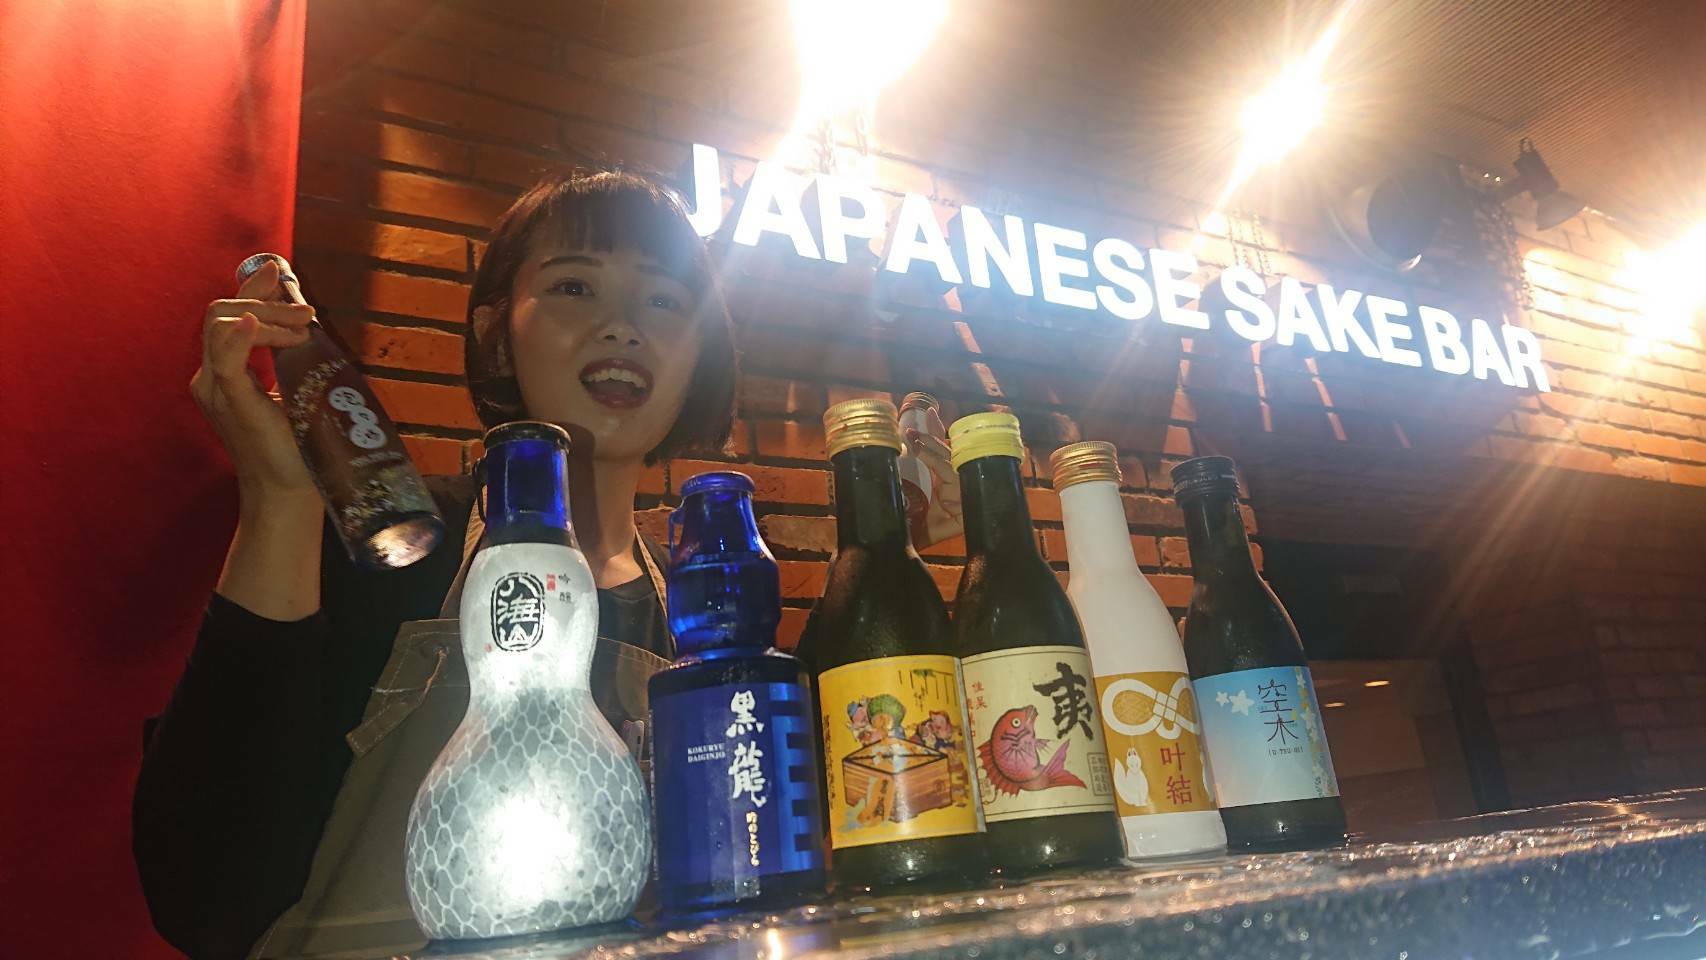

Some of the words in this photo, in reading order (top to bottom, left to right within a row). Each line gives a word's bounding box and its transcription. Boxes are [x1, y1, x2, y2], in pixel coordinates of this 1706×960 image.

[689, 143, 1210, 331] JAPANESE
[1219, 264, 1423, 368] SAKE
[1418, 304, 1551, 393] BAR
[1257, 678, 1299, 745] 空木
[687, 742, 726, 755] KOKURYU
[687, 751, 727, 763] DAIGINJO
[725, 690, 767, 808] 黒龍
[1159, 742, 1193, 805] 叶結
